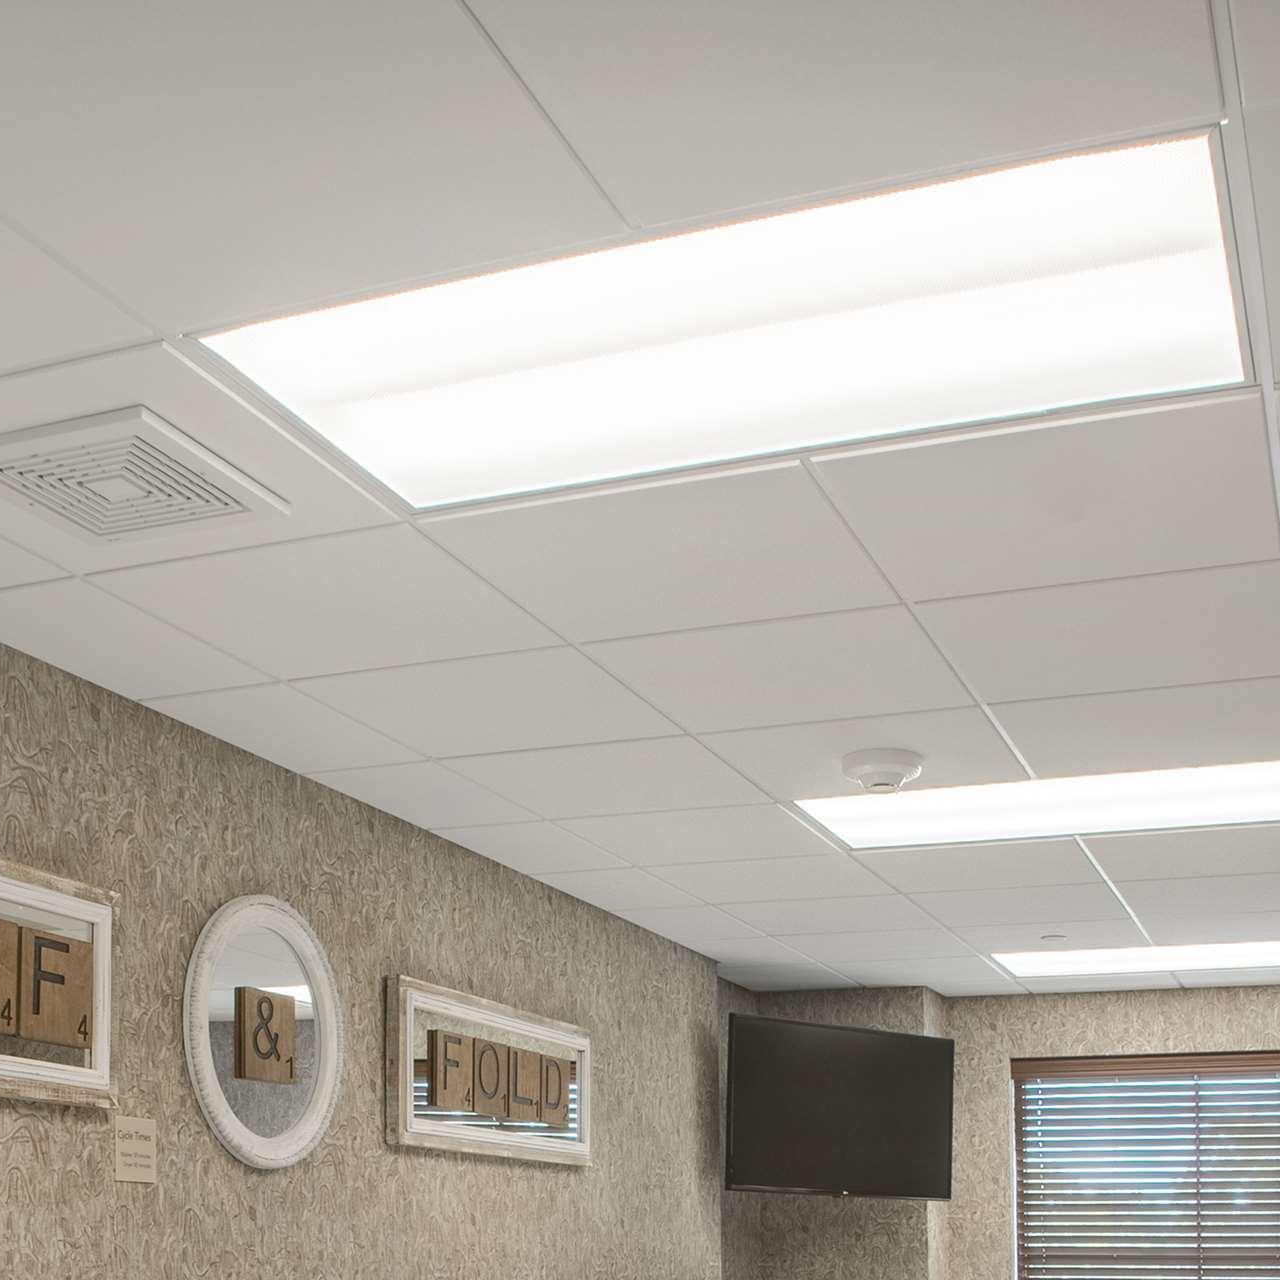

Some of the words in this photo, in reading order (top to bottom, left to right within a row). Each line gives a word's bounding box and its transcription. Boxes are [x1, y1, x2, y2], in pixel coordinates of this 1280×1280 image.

[0, 998, 12, 1027] 4
[77, 1014, 89, 1042] 4
[253, 996, 280, 1062] &
[286, 1056, 293, 1079] 1
[443, 1035, 562, 1110] FOLD
